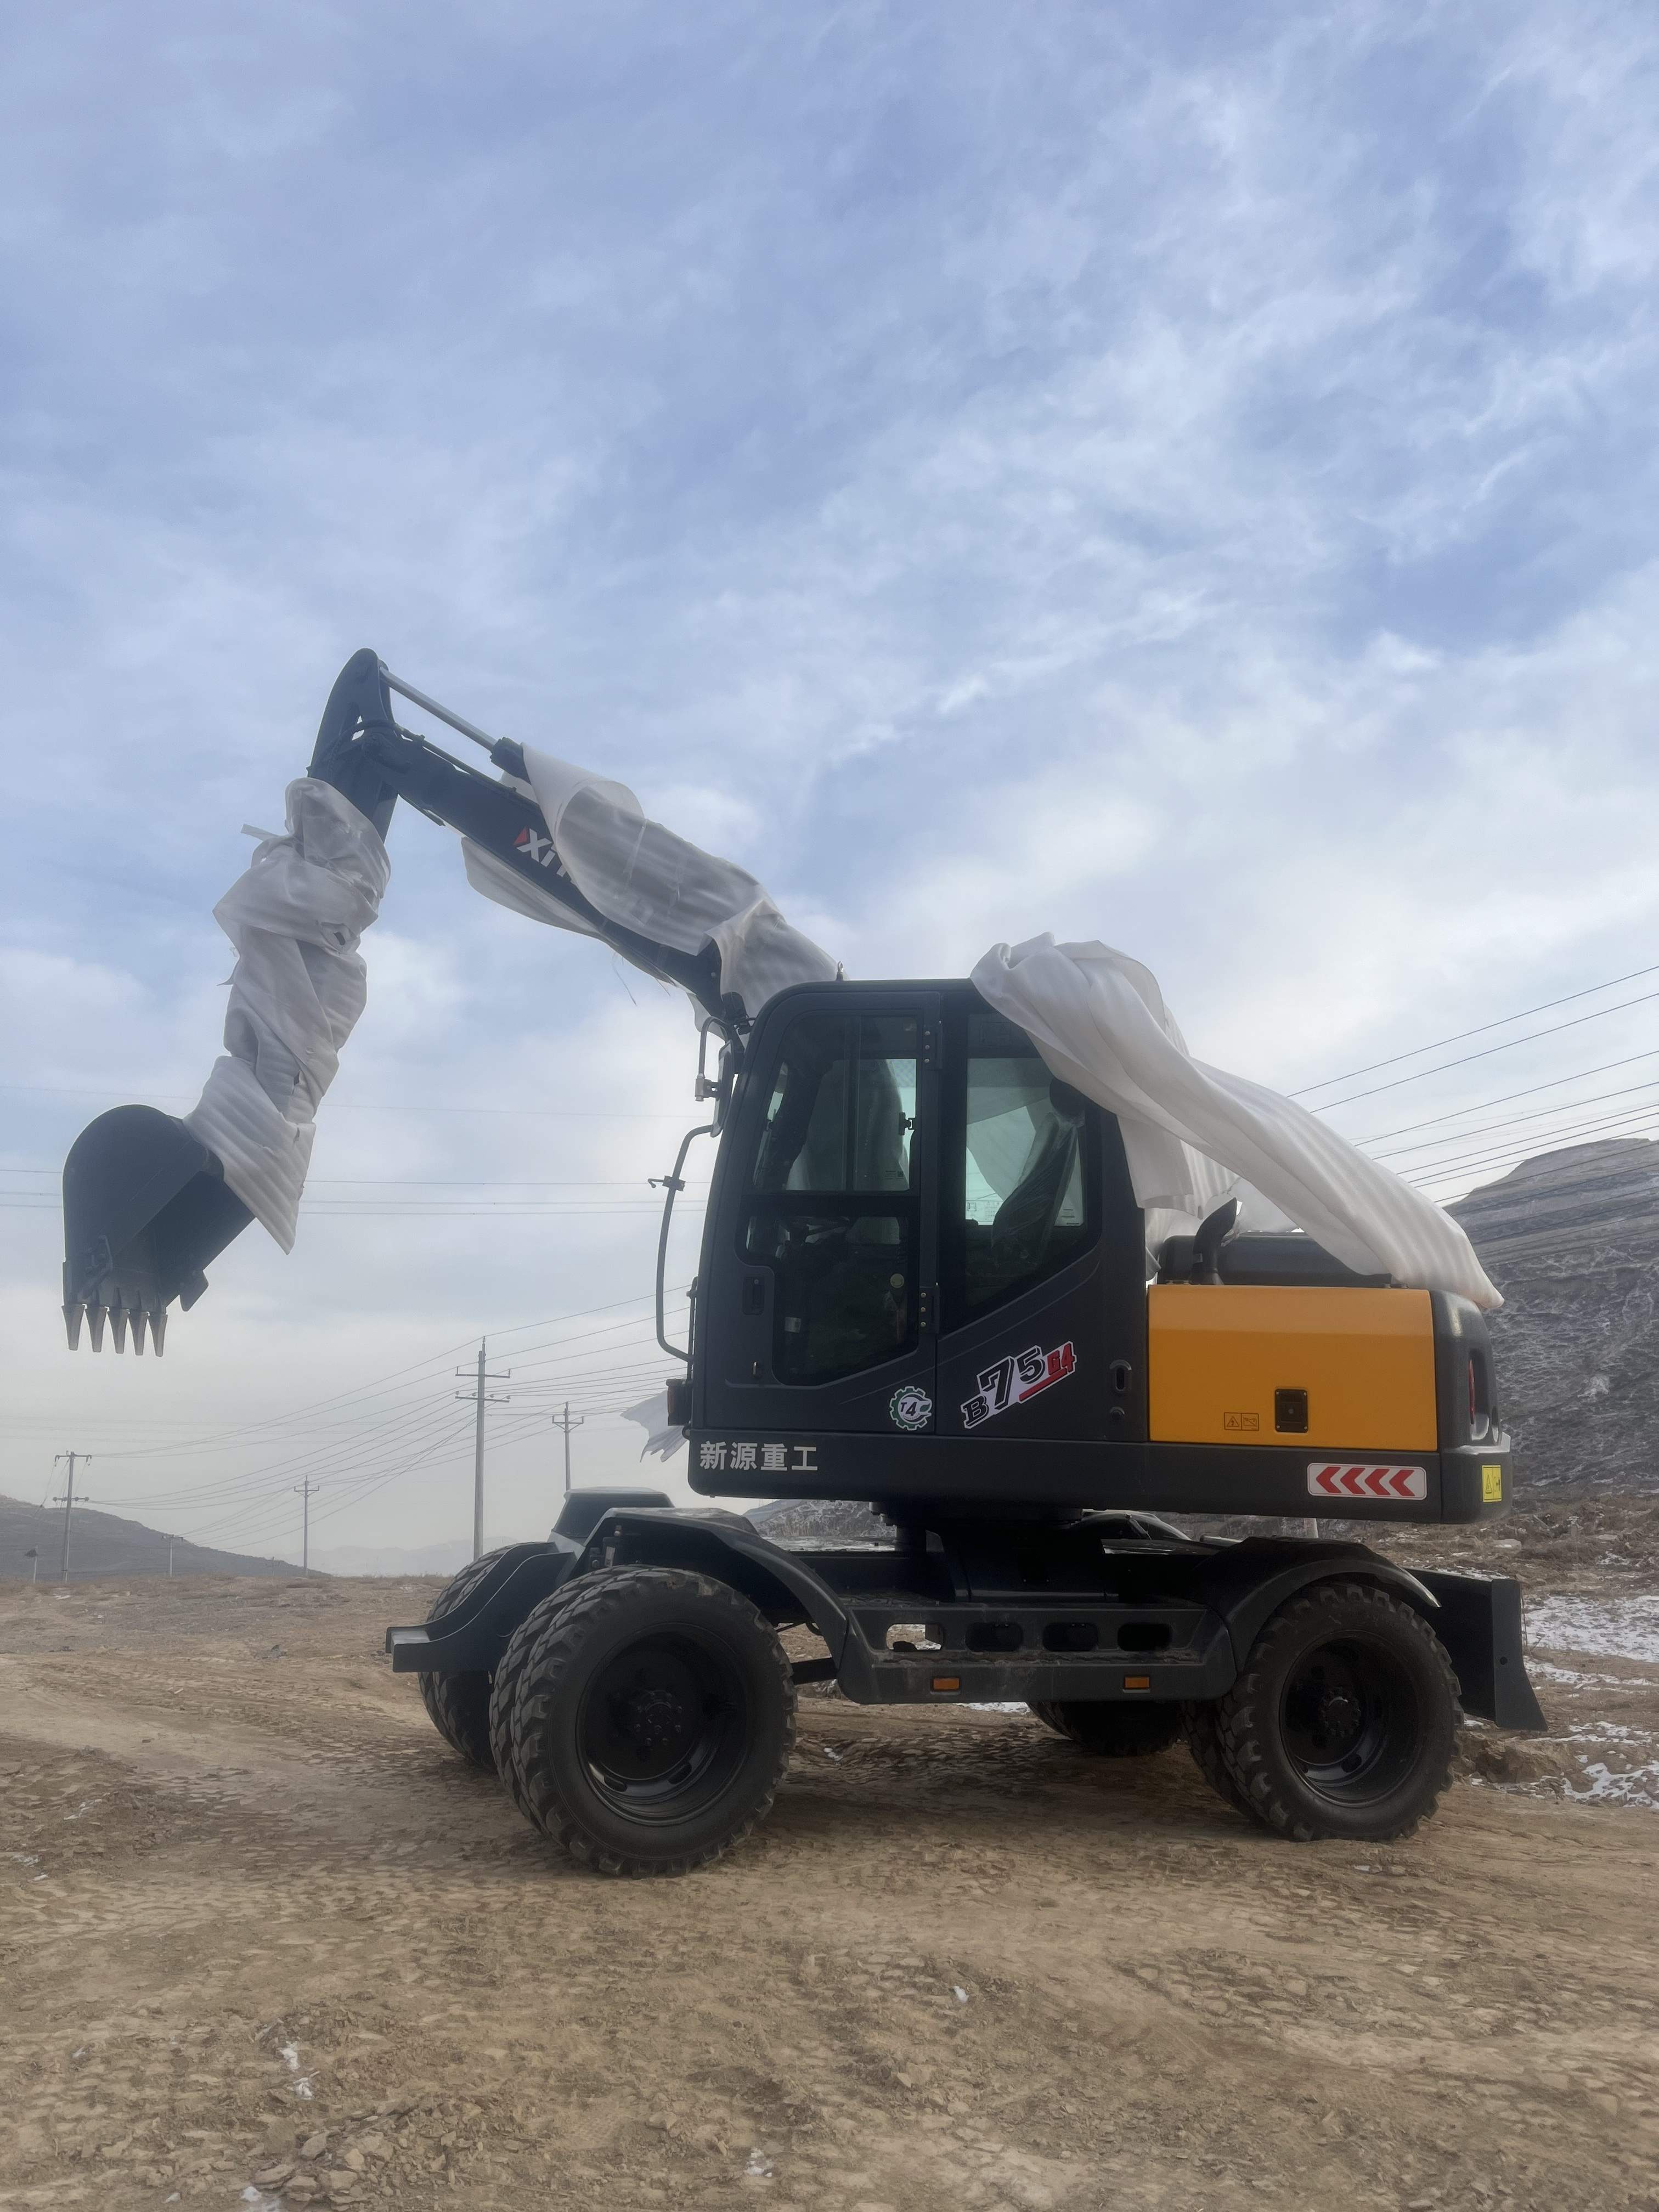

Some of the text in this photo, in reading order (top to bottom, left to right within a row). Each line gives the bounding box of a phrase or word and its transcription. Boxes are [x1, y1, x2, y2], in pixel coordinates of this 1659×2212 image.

[900, 1402, 917, 1416] T4
[699, 1441, 818, 1471] 新源重工
